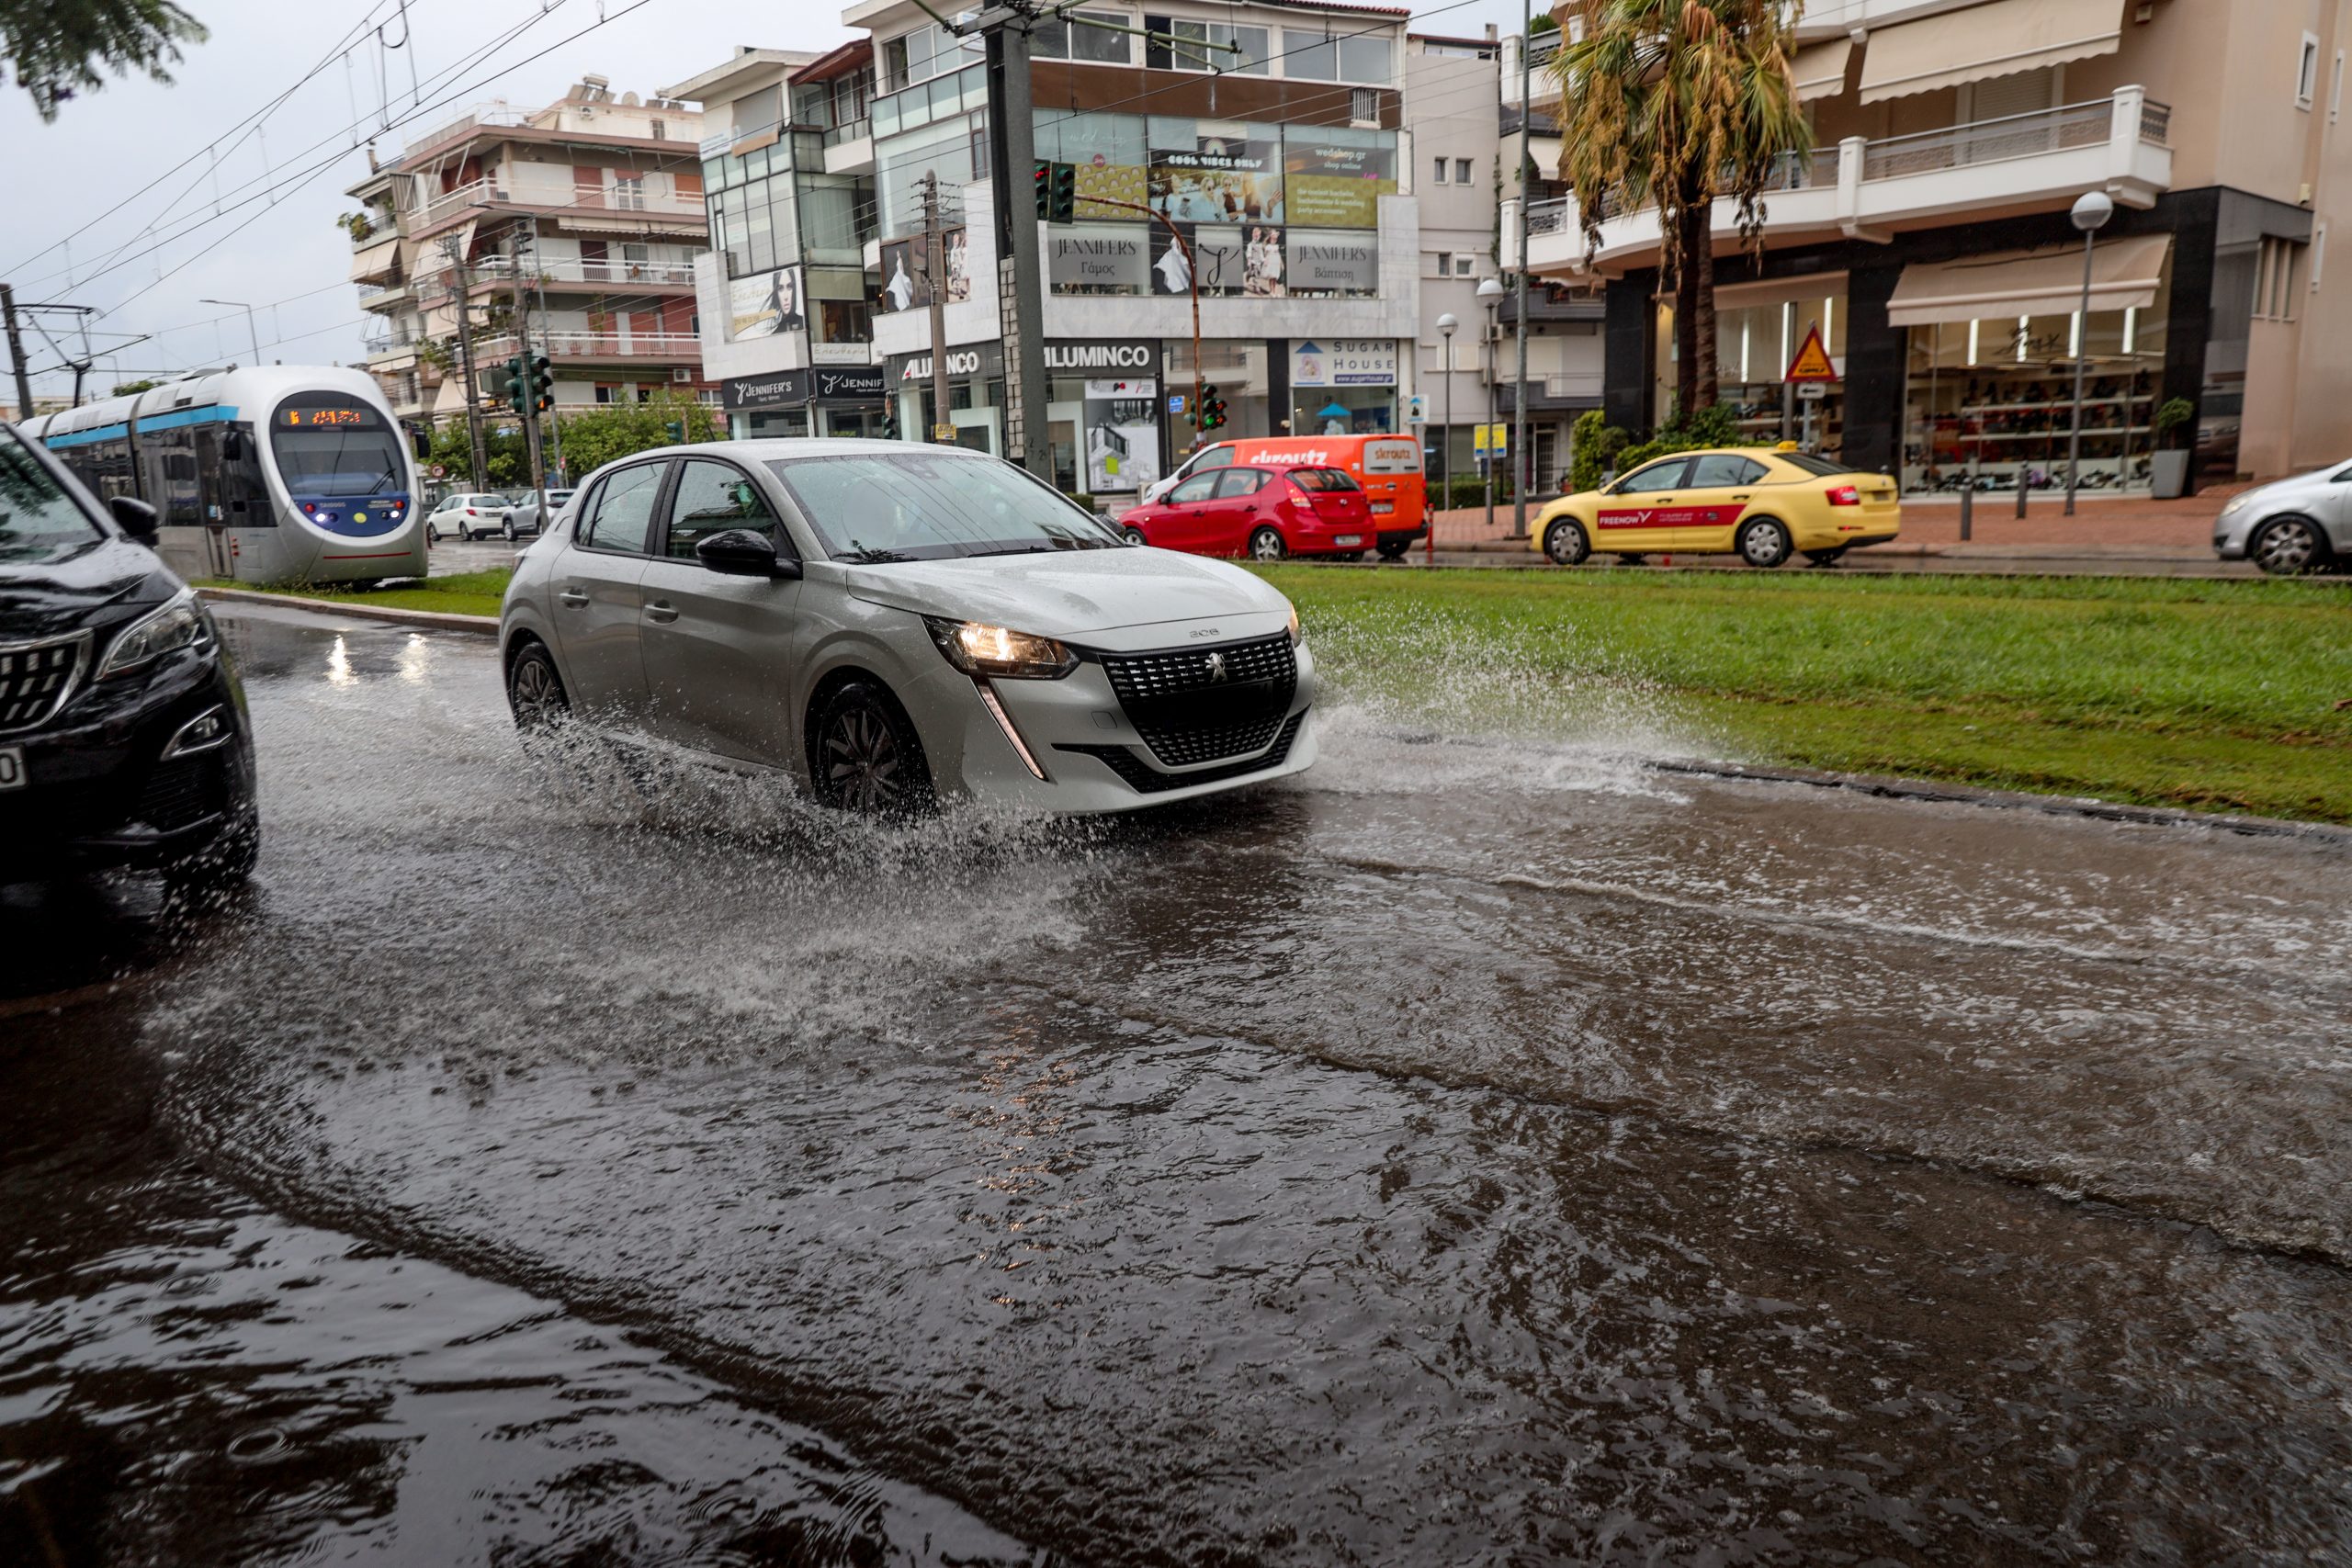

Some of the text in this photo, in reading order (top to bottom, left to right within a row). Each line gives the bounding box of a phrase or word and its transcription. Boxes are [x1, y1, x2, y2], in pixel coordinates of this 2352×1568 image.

[1315, 148, 1366, 161] wedshop.gr
[1081, 260, 1115, 276] Γάμος
[1315, 266, 1354, 281] Βάπτιση
[1334, 341, 1393, 352] SUGAR
[902, 351, 979, 380] ALUNCO
[1334, 358, 1394, 369] HOUSE
[1374, 447, 1411, 459] skroutz
